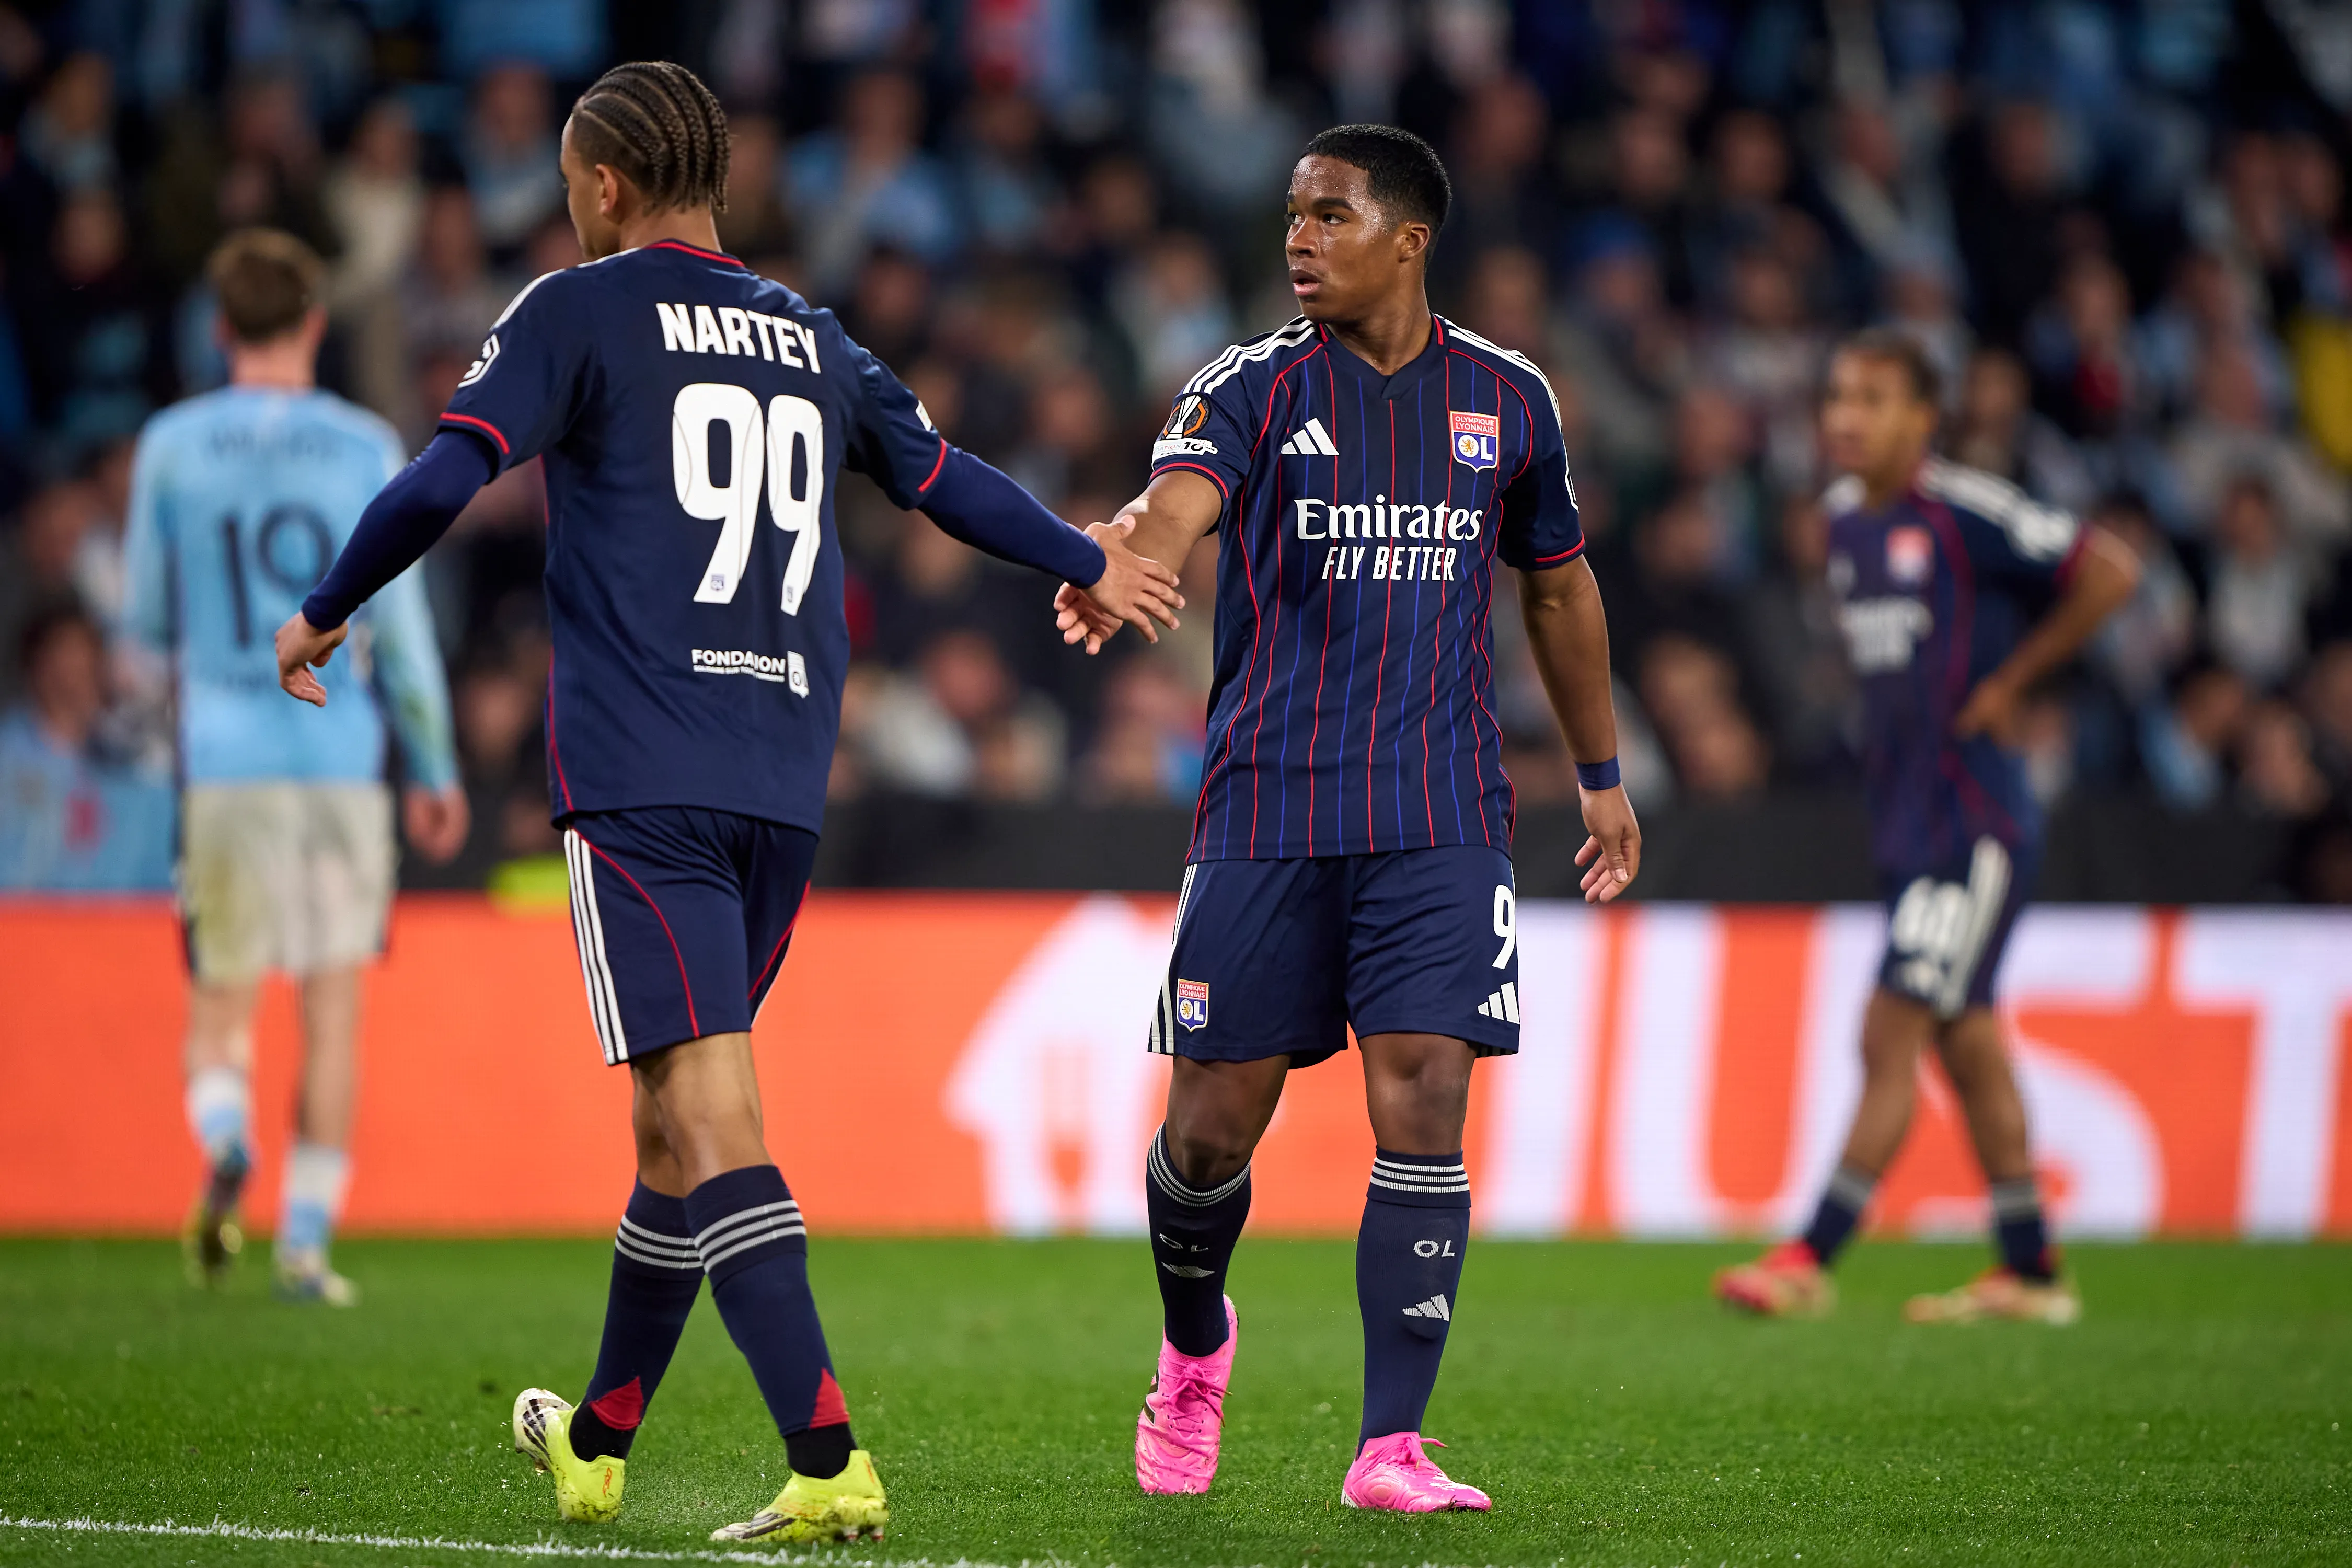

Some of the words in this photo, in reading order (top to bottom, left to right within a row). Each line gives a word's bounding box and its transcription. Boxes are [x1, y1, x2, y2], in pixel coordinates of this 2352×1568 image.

[655, 302, 821, 374] NARTEY
[1455, 416, 1494, 426] OLYMPIQUE
[1455, 422, 1494, 434] LYONNAIS
[1457, 434, 1494, 462] OL
[672, 382, 824, 617] 99
[1293, 494, 1483, 541] Emirates
[218, 501, 337, 651] 19
[1321, 546, 1366, 581] FLY
[1371, 546, 1457, 582] BETTER
[691, 649, 786, 674] FONDAION
[1492, 884, 1516, 970] 9
[1179, 983, 1205, 992] OLYMPIQUE
[1179, 989, 1205, 998] LYONNAIS
[1180, 999, 1204, 1022] OL
[1413, 1239, 1456, 1259] OL
